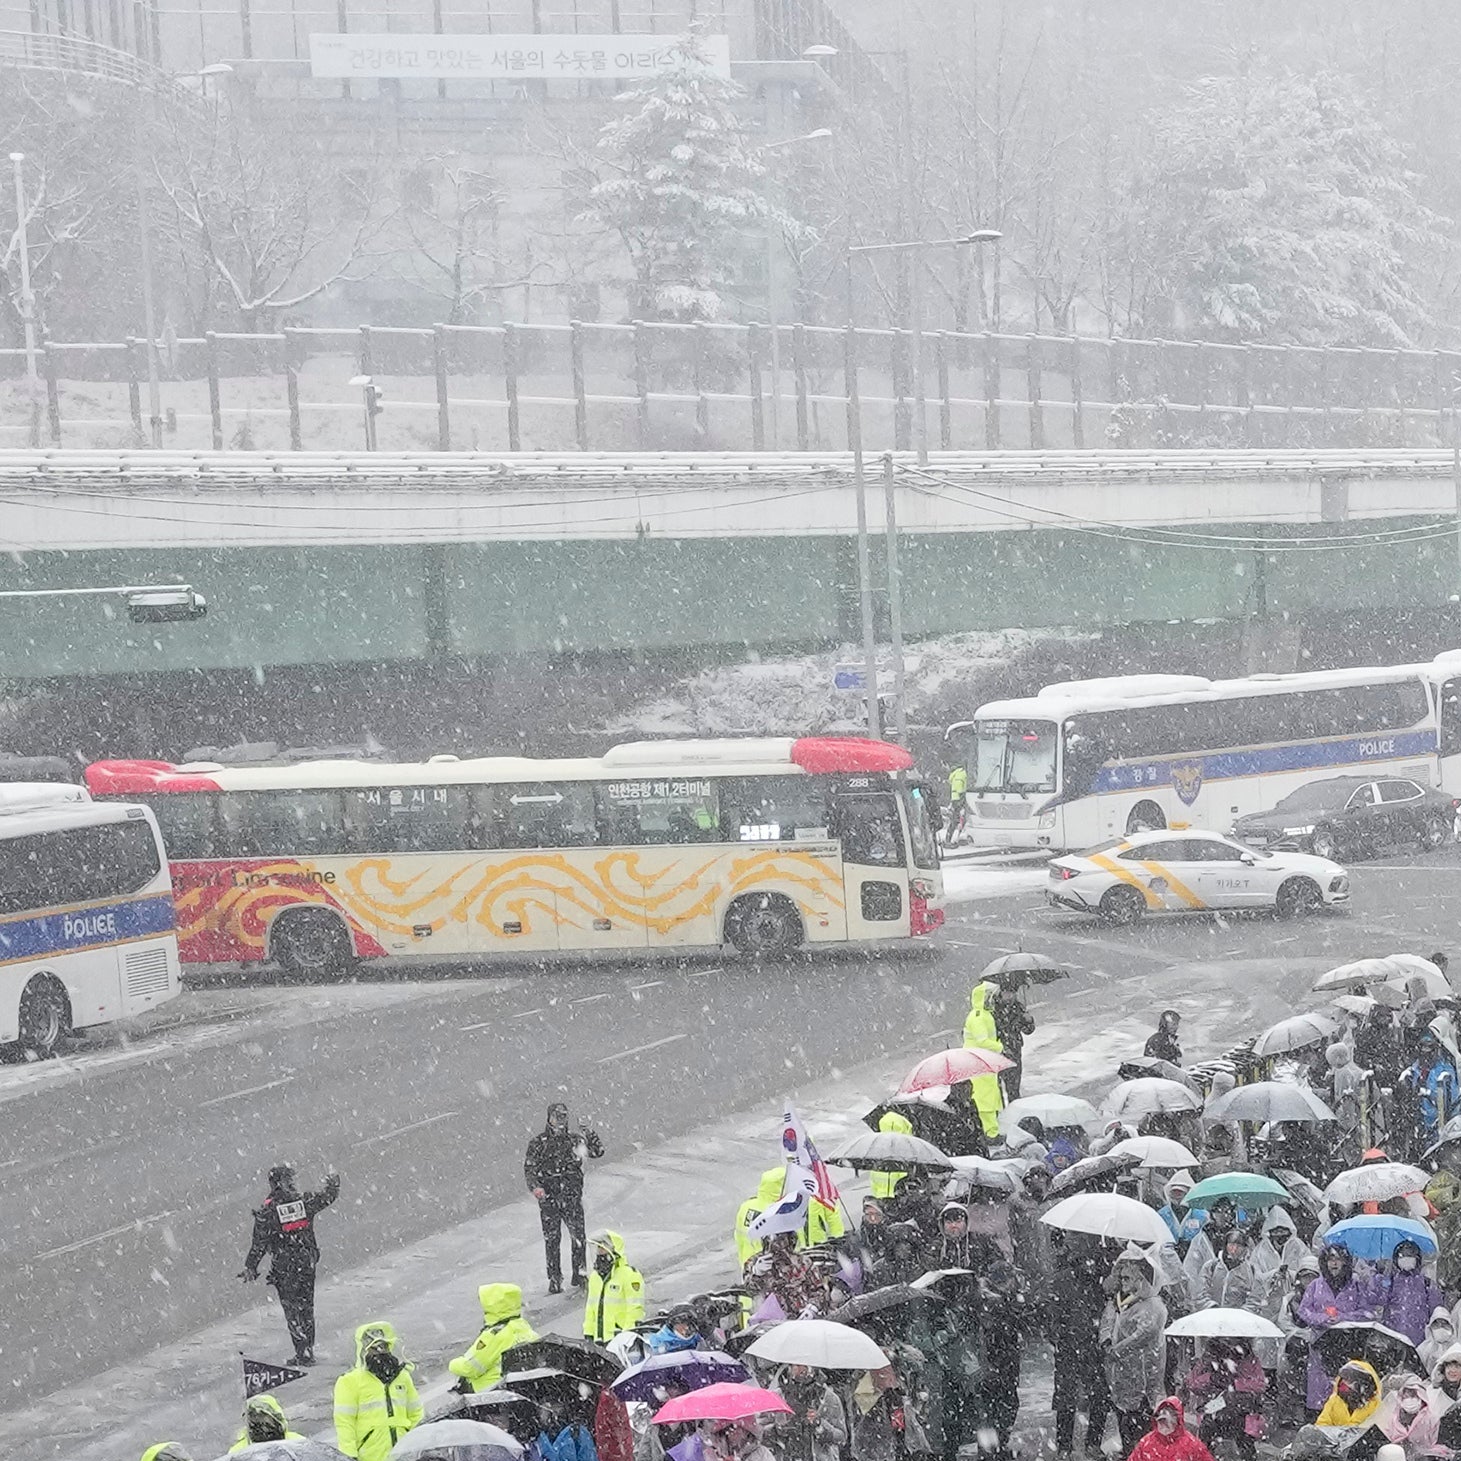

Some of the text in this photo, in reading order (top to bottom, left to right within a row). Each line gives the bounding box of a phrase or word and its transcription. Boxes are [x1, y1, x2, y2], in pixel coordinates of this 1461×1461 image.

[348, 47, 421, 70] 건강하고
[426, 48, 482, 70] 맛있는
[490, 49, 545, 71] 서울의
[552, 49, 609, 74] 수돗물
[1359, 739, 1396, 756] POLICE
[848, 777, 870, 788] 288
[1132, 766, 1157, 783] 경찰
[607, 783, 652, 799] 인천공항
[63, 913, 116, 940] POLICE
